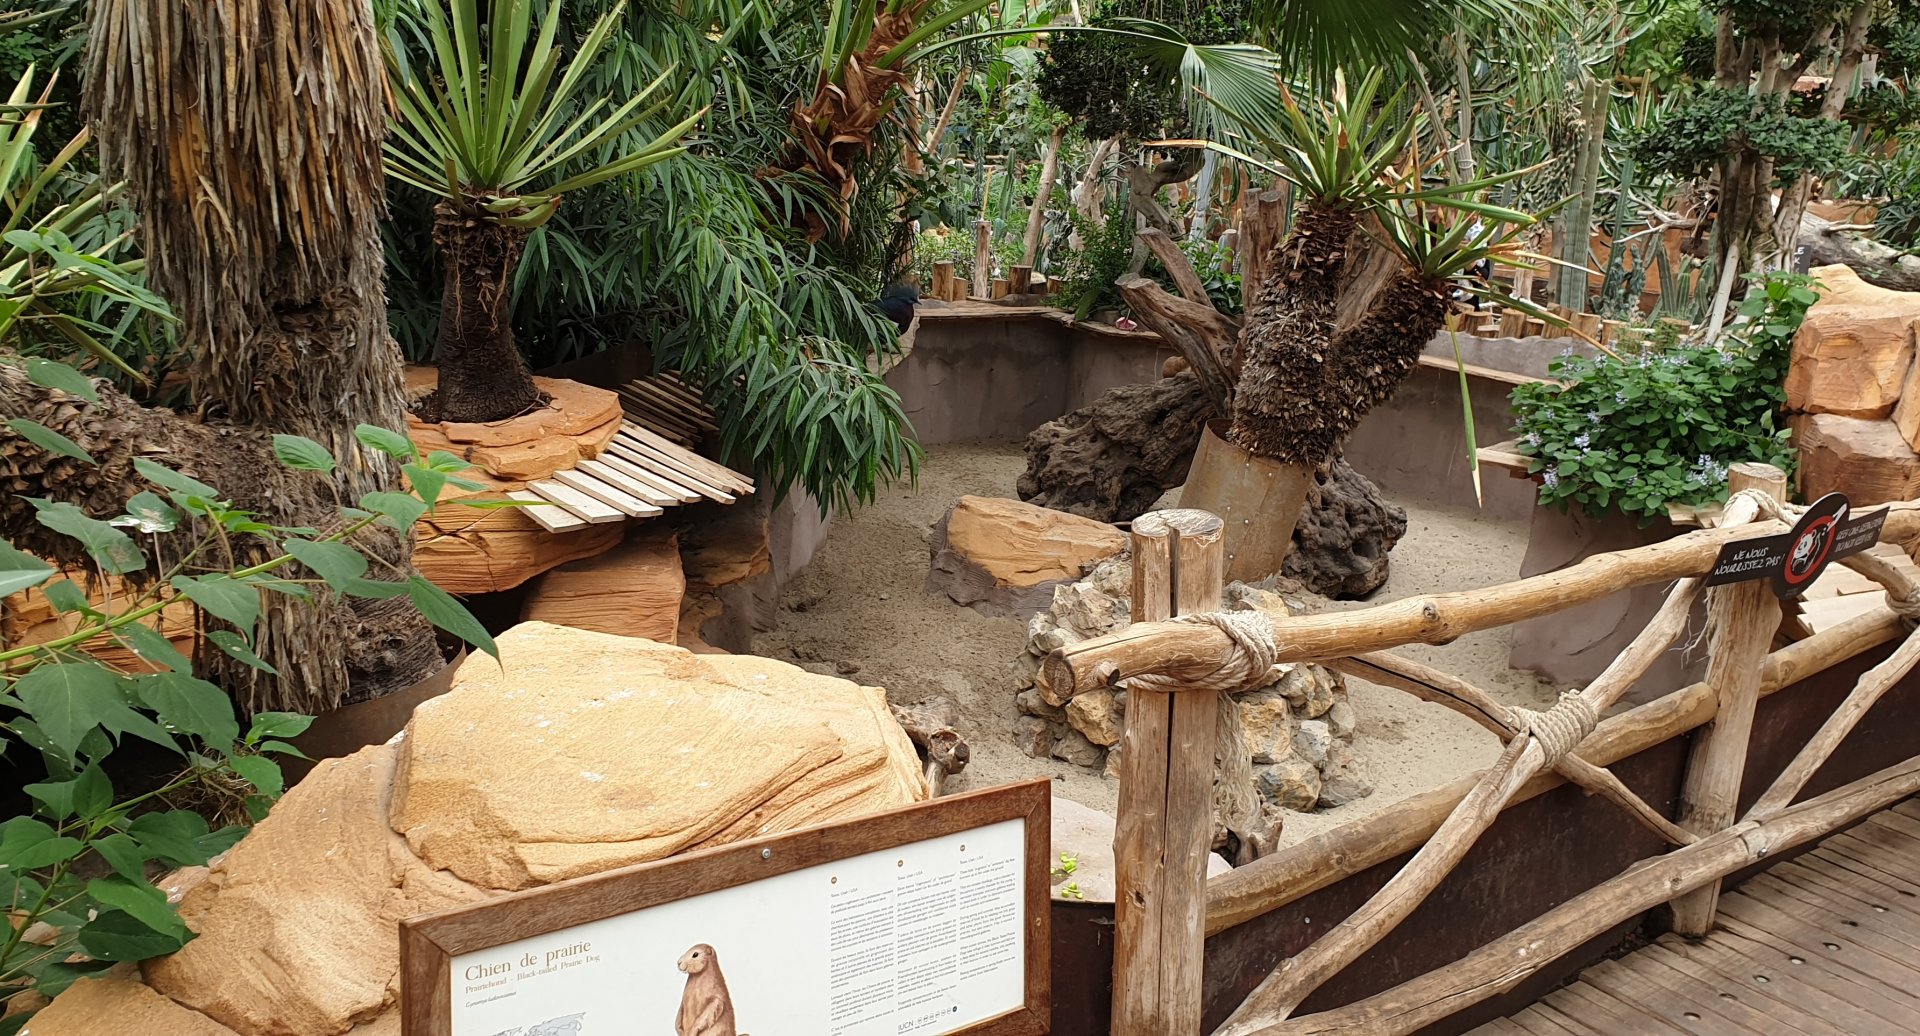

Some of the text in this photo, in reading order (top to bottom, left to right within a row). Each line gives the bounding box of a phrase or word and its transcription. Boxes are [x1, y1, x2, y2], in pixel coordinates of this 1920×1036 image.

[1733, 547, 1769, 561] NE NOUS
[1714, 559, 1764, 576] NOURRISSEZ
[465, 941, 591, 981] Chien de prairie
[465, 977, 507, 994] Prairiehond
[517, 964, 558, 981] Black-tailed
[560, 957, 583, 970] Prairie
[585, 954, 601, 965] Dog
[897, 1020, 914, 1031] IUCN
